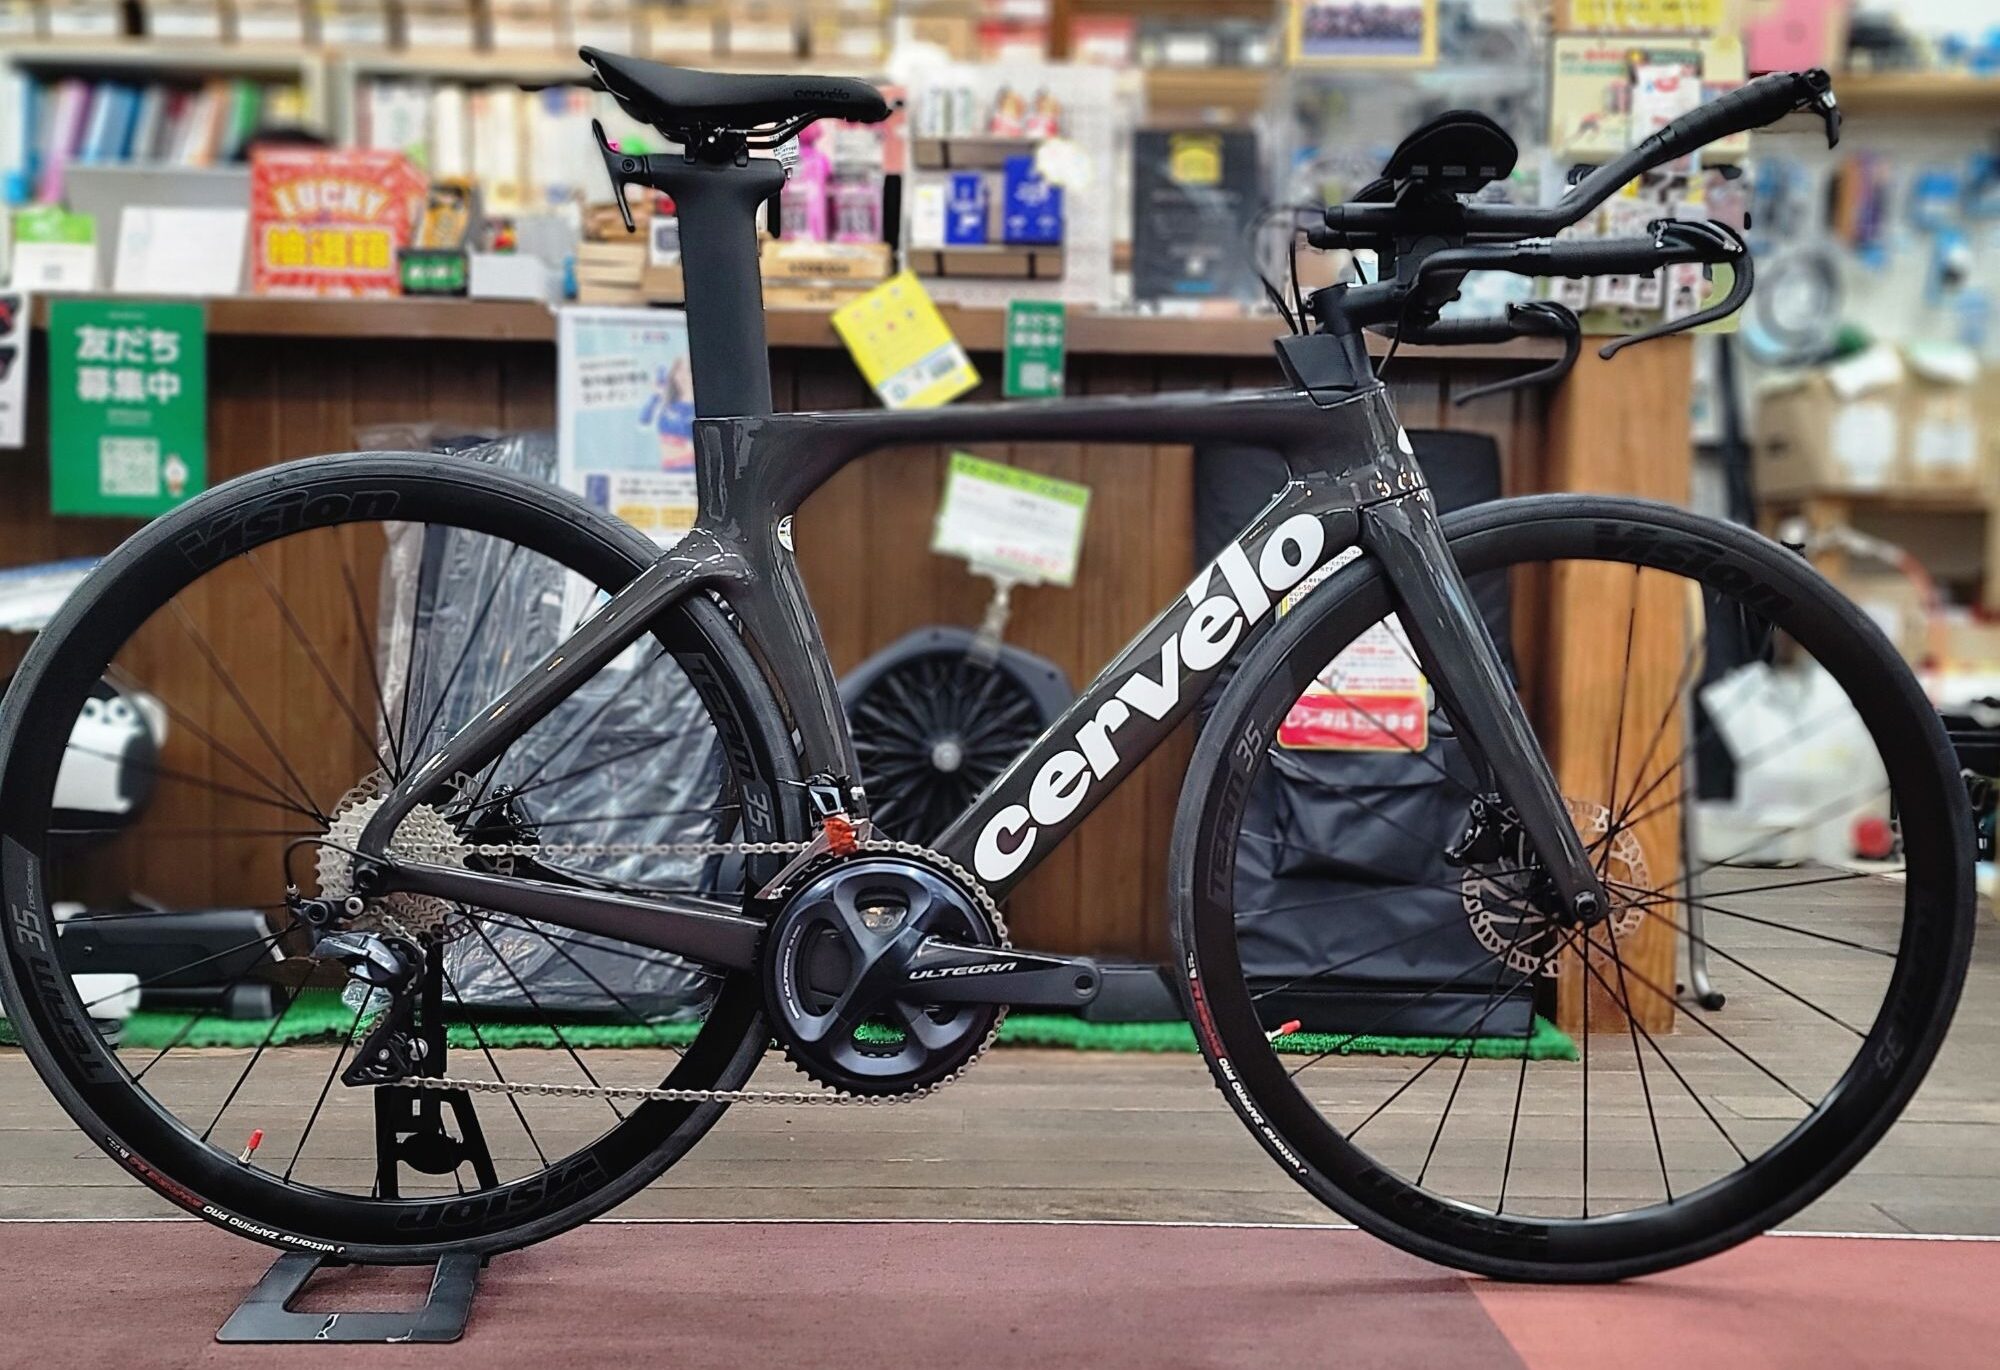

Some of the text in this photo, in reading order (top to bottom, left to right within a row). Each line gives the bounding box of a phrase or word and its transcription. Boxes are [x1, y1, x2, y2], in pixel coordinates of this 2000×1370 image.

[273, 180, 391, 218] LUCKY
[974, 514, 1325, 883] cervélo
[1235, 719, 1263, 773] 35
[742, 784, 772, 834] 35
[11, 903, 47, 953] 35
[909, 961, 1018, 980] ULTEGRA
[202, 1204, 229, 1221] PRO
